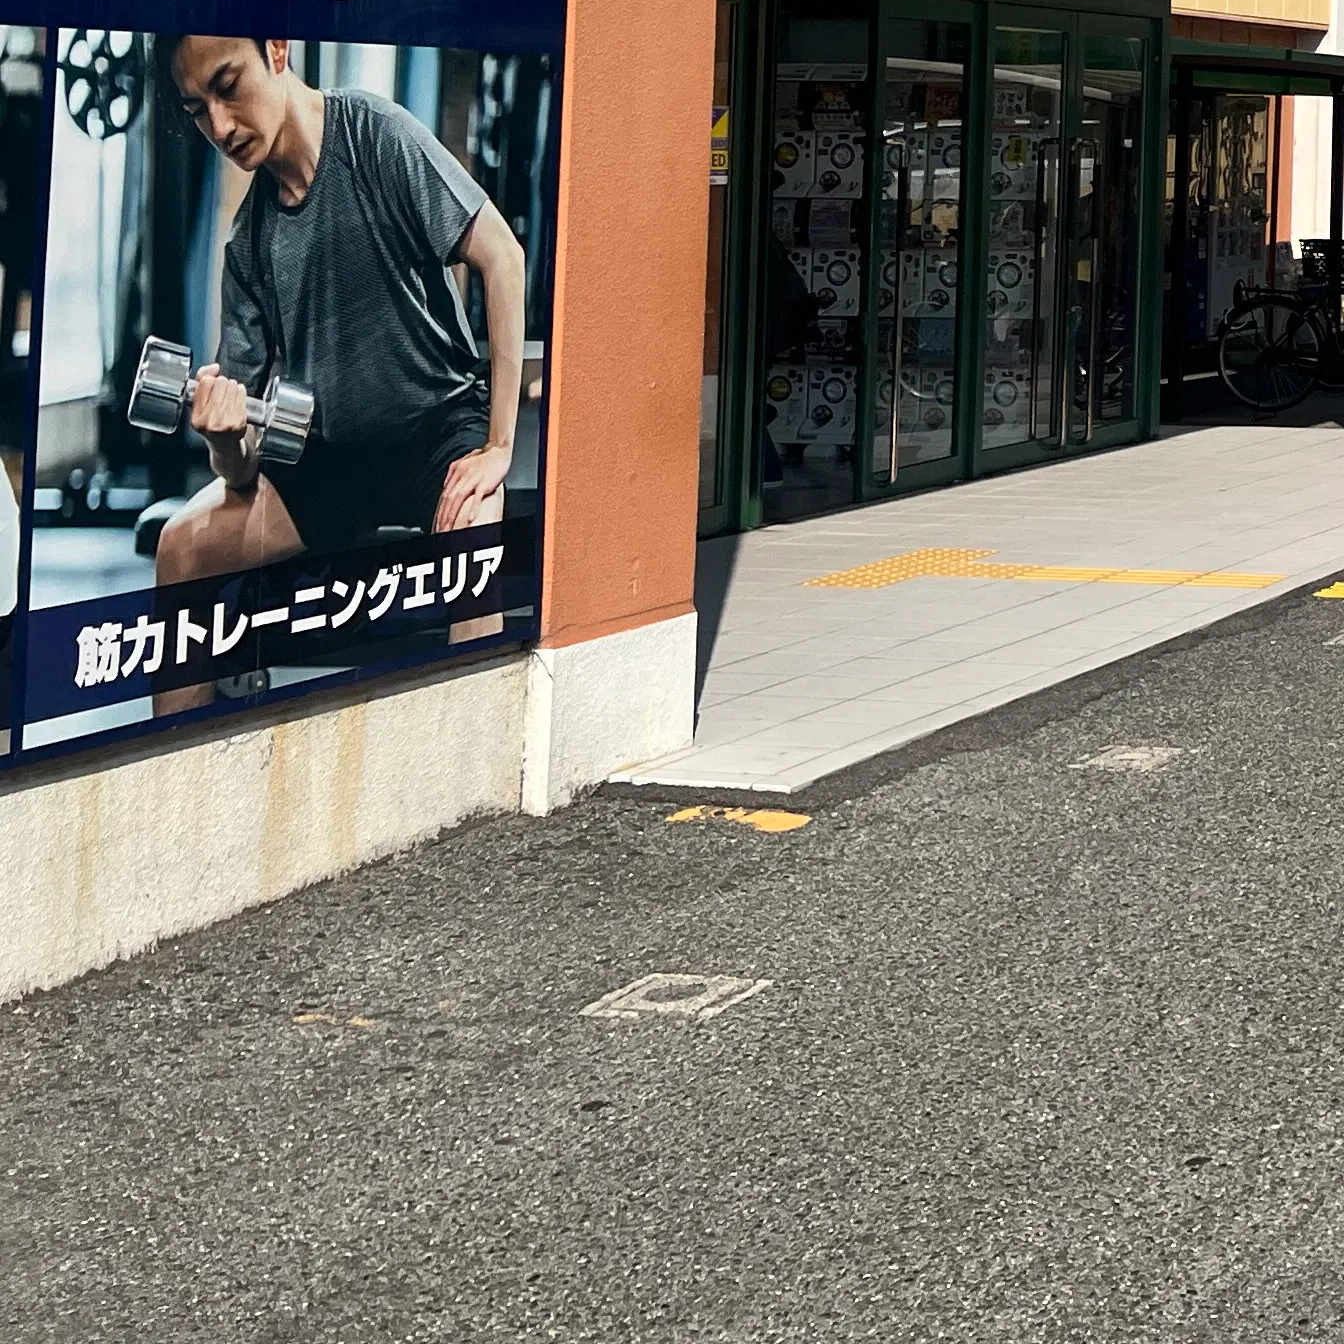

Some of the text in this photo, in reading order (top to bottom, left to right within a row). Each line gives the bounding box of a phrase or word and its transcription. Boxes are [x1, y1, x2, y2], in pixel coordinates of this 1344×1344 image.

[75, 545, 504, 689] 筋力トレーニングエリア
